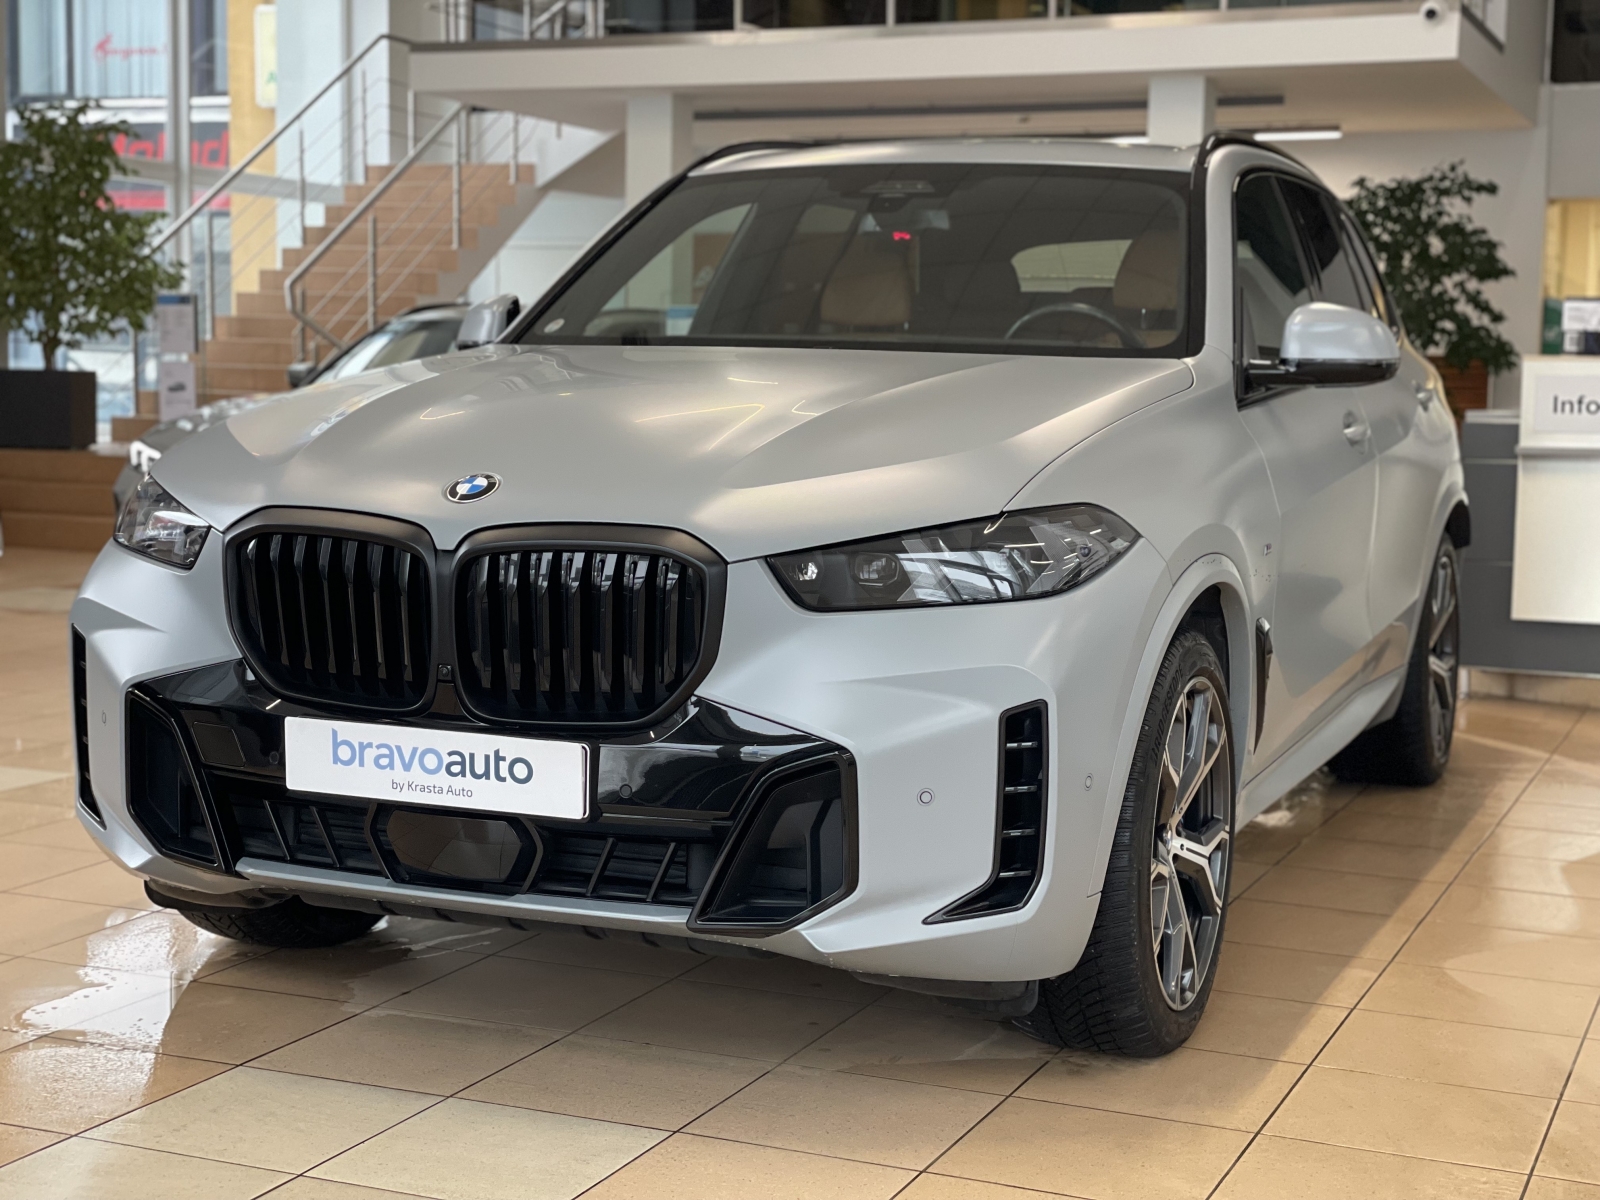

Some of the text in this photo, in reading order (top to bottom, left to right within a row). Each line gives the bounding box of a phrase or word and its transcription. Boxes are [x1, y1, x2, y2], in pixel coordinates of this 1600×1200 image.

[1553, 395, 1600, 415] Info
[331, 728, 534, 785] bravoauto
[391, 779, 473, 798] by Krasta Auto
